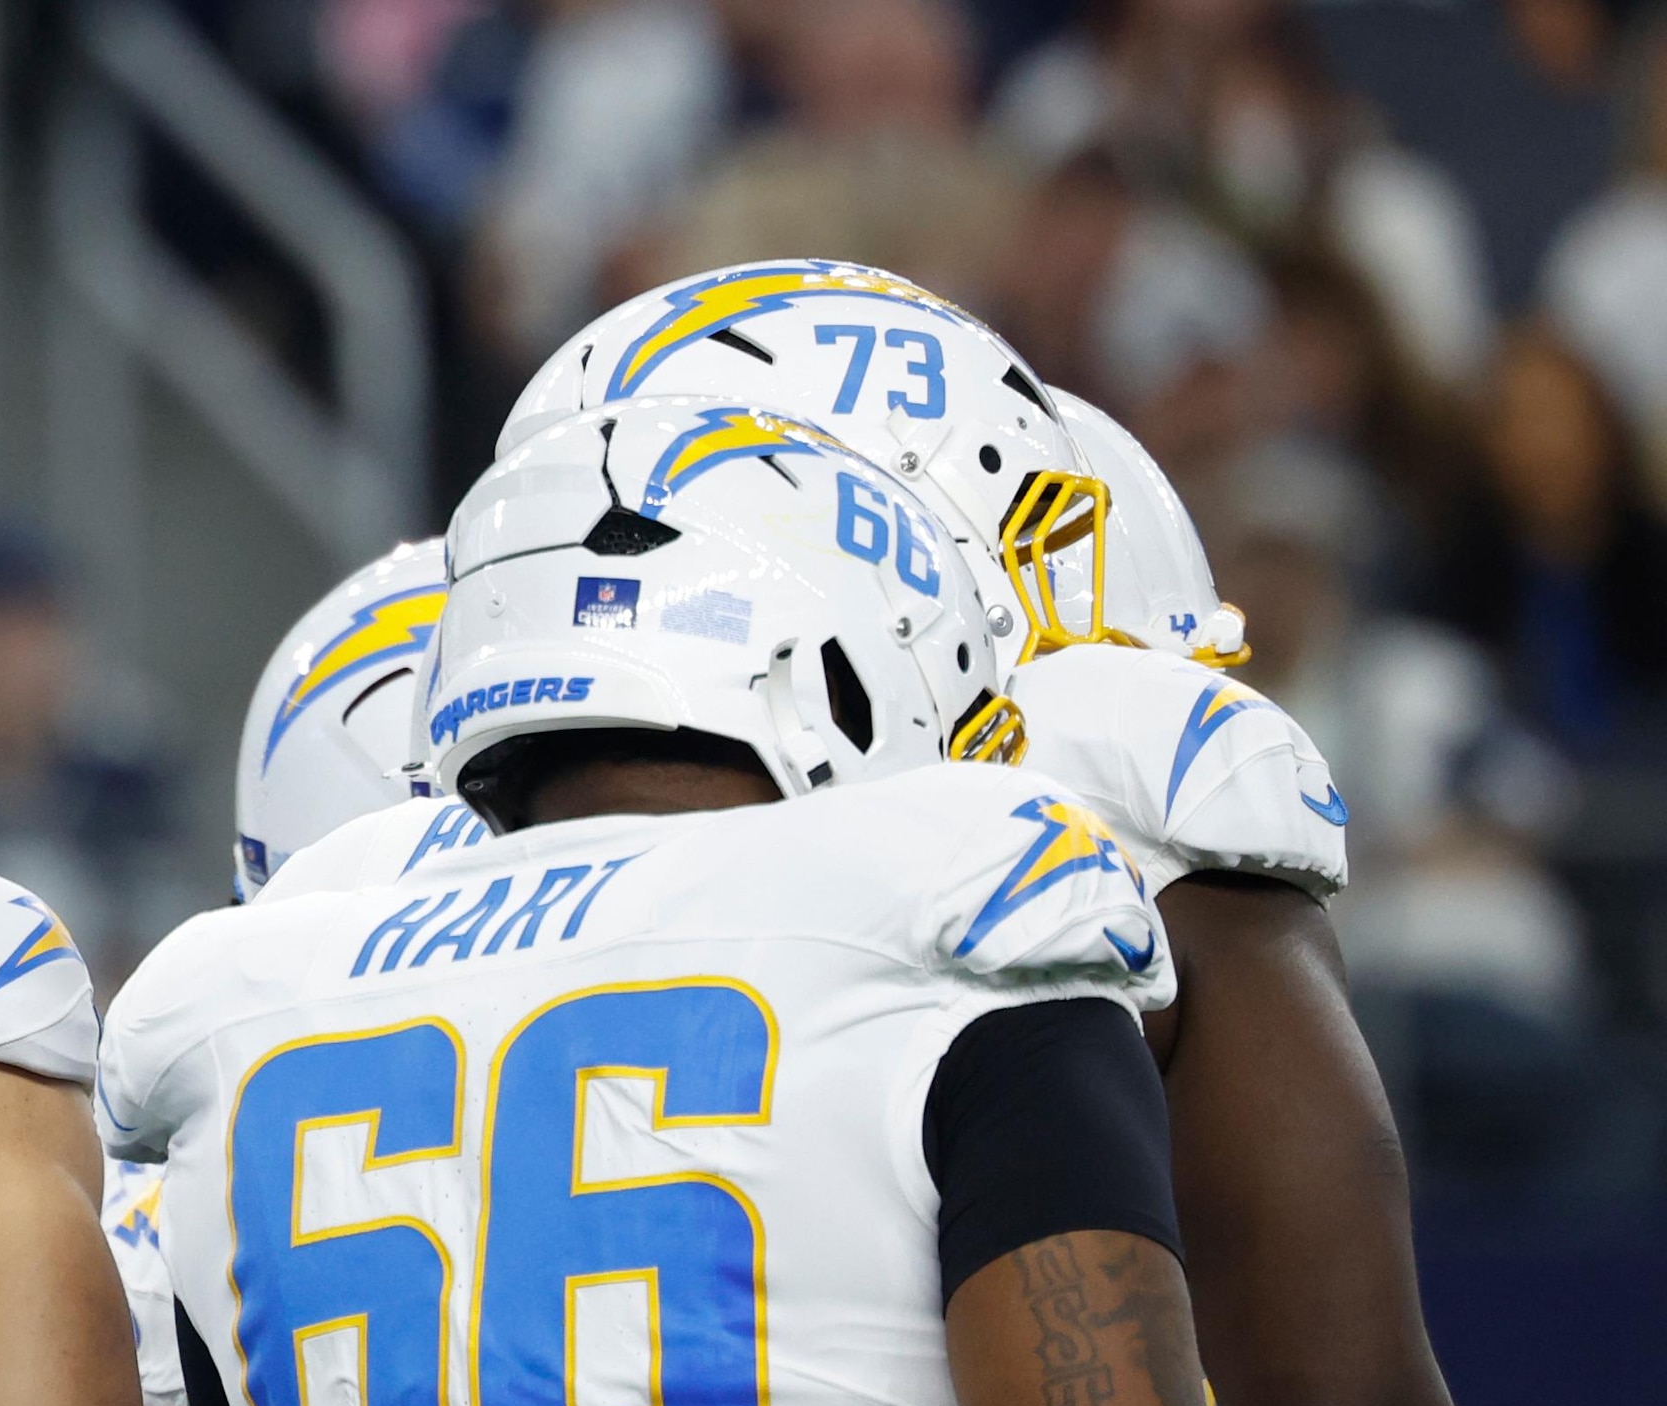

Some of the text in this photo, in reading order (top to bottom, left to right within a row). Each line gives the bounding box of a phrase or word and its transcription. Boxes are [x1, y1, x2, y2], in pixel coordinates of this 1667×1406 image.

[814, 324, 946, 419] 73
[836, 471, 941, 599] 66
[348, 848, 652, 979] HART
